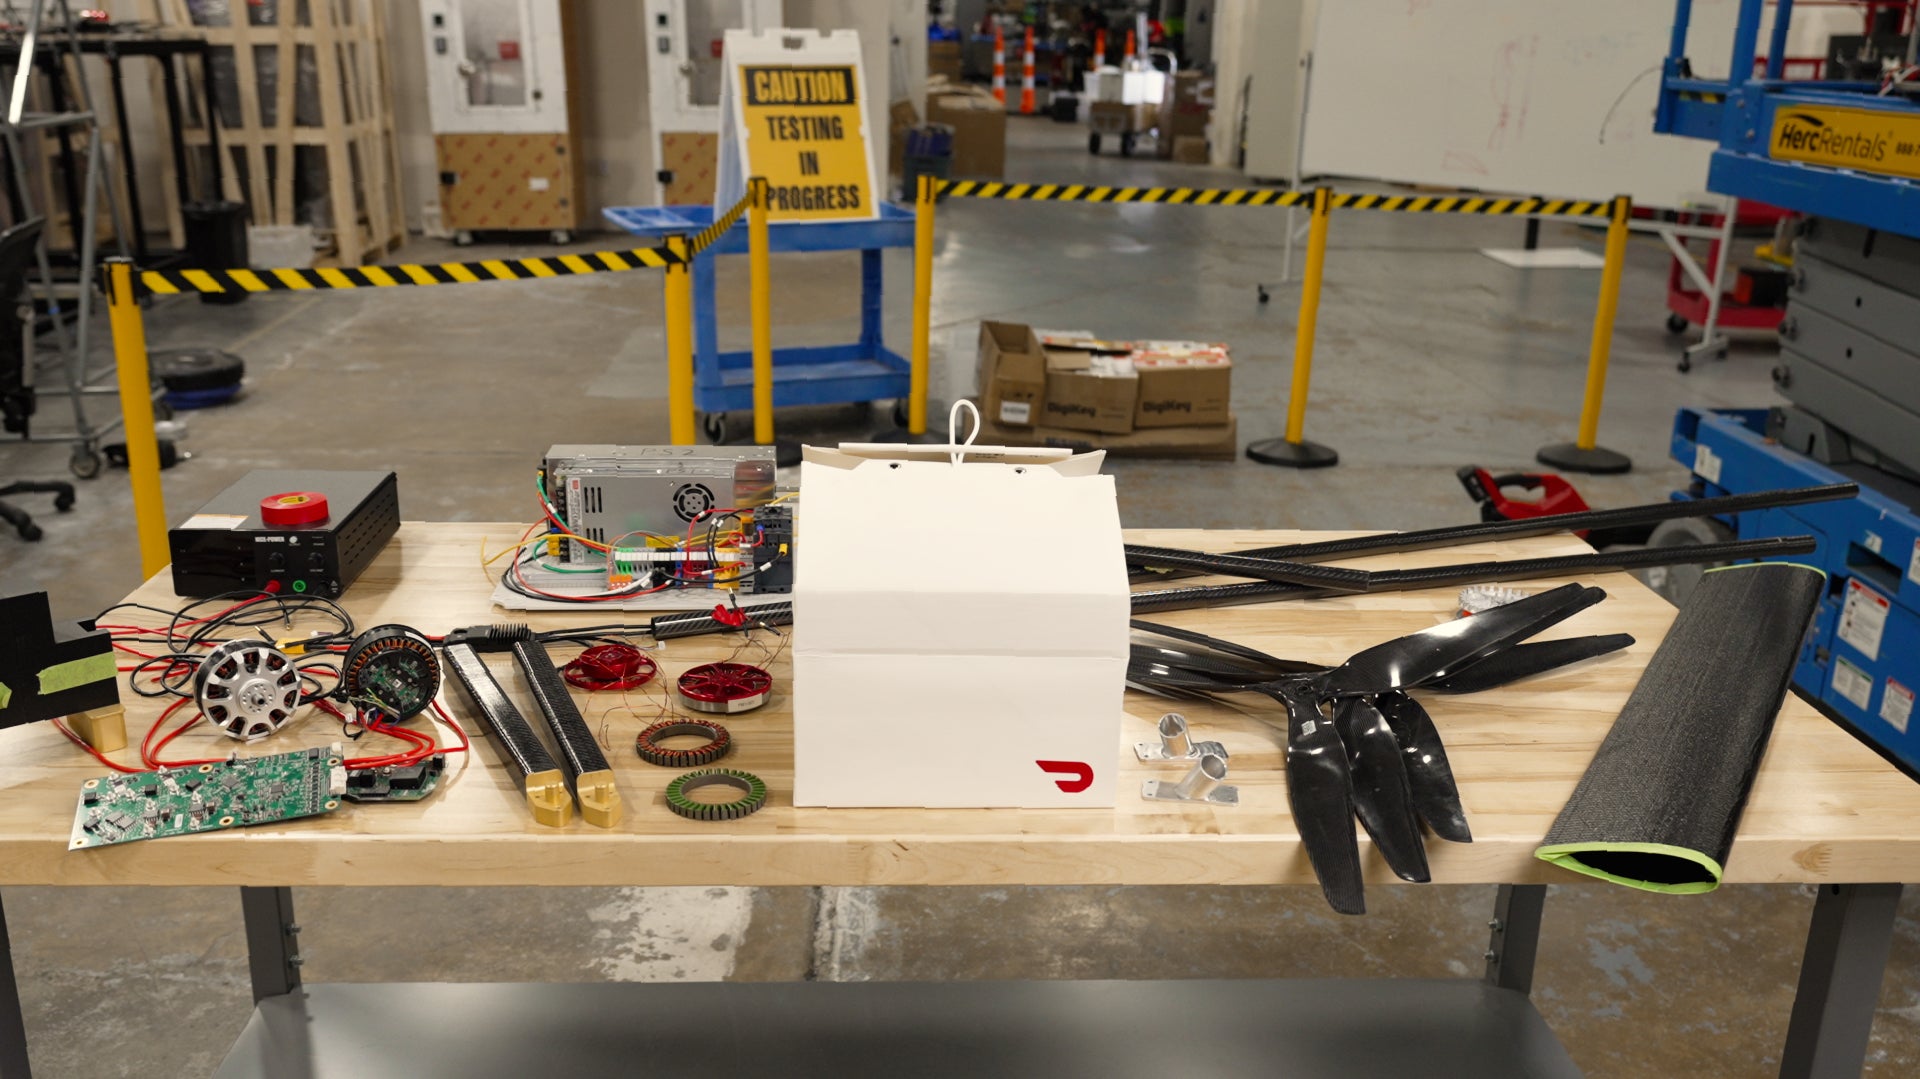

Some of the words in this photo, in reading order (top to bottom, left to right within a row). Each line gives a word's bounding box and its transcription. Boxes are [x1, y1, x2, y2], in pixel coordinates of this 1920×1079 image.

[753, 70, 848, 103] CAUTION
[766, 115, 844, 141] TESTING
[1779, 123, 1887, 161] HercRentals
[799, 151, 820, 175] IN
[765, 184, 861, 211] PROGRESS
